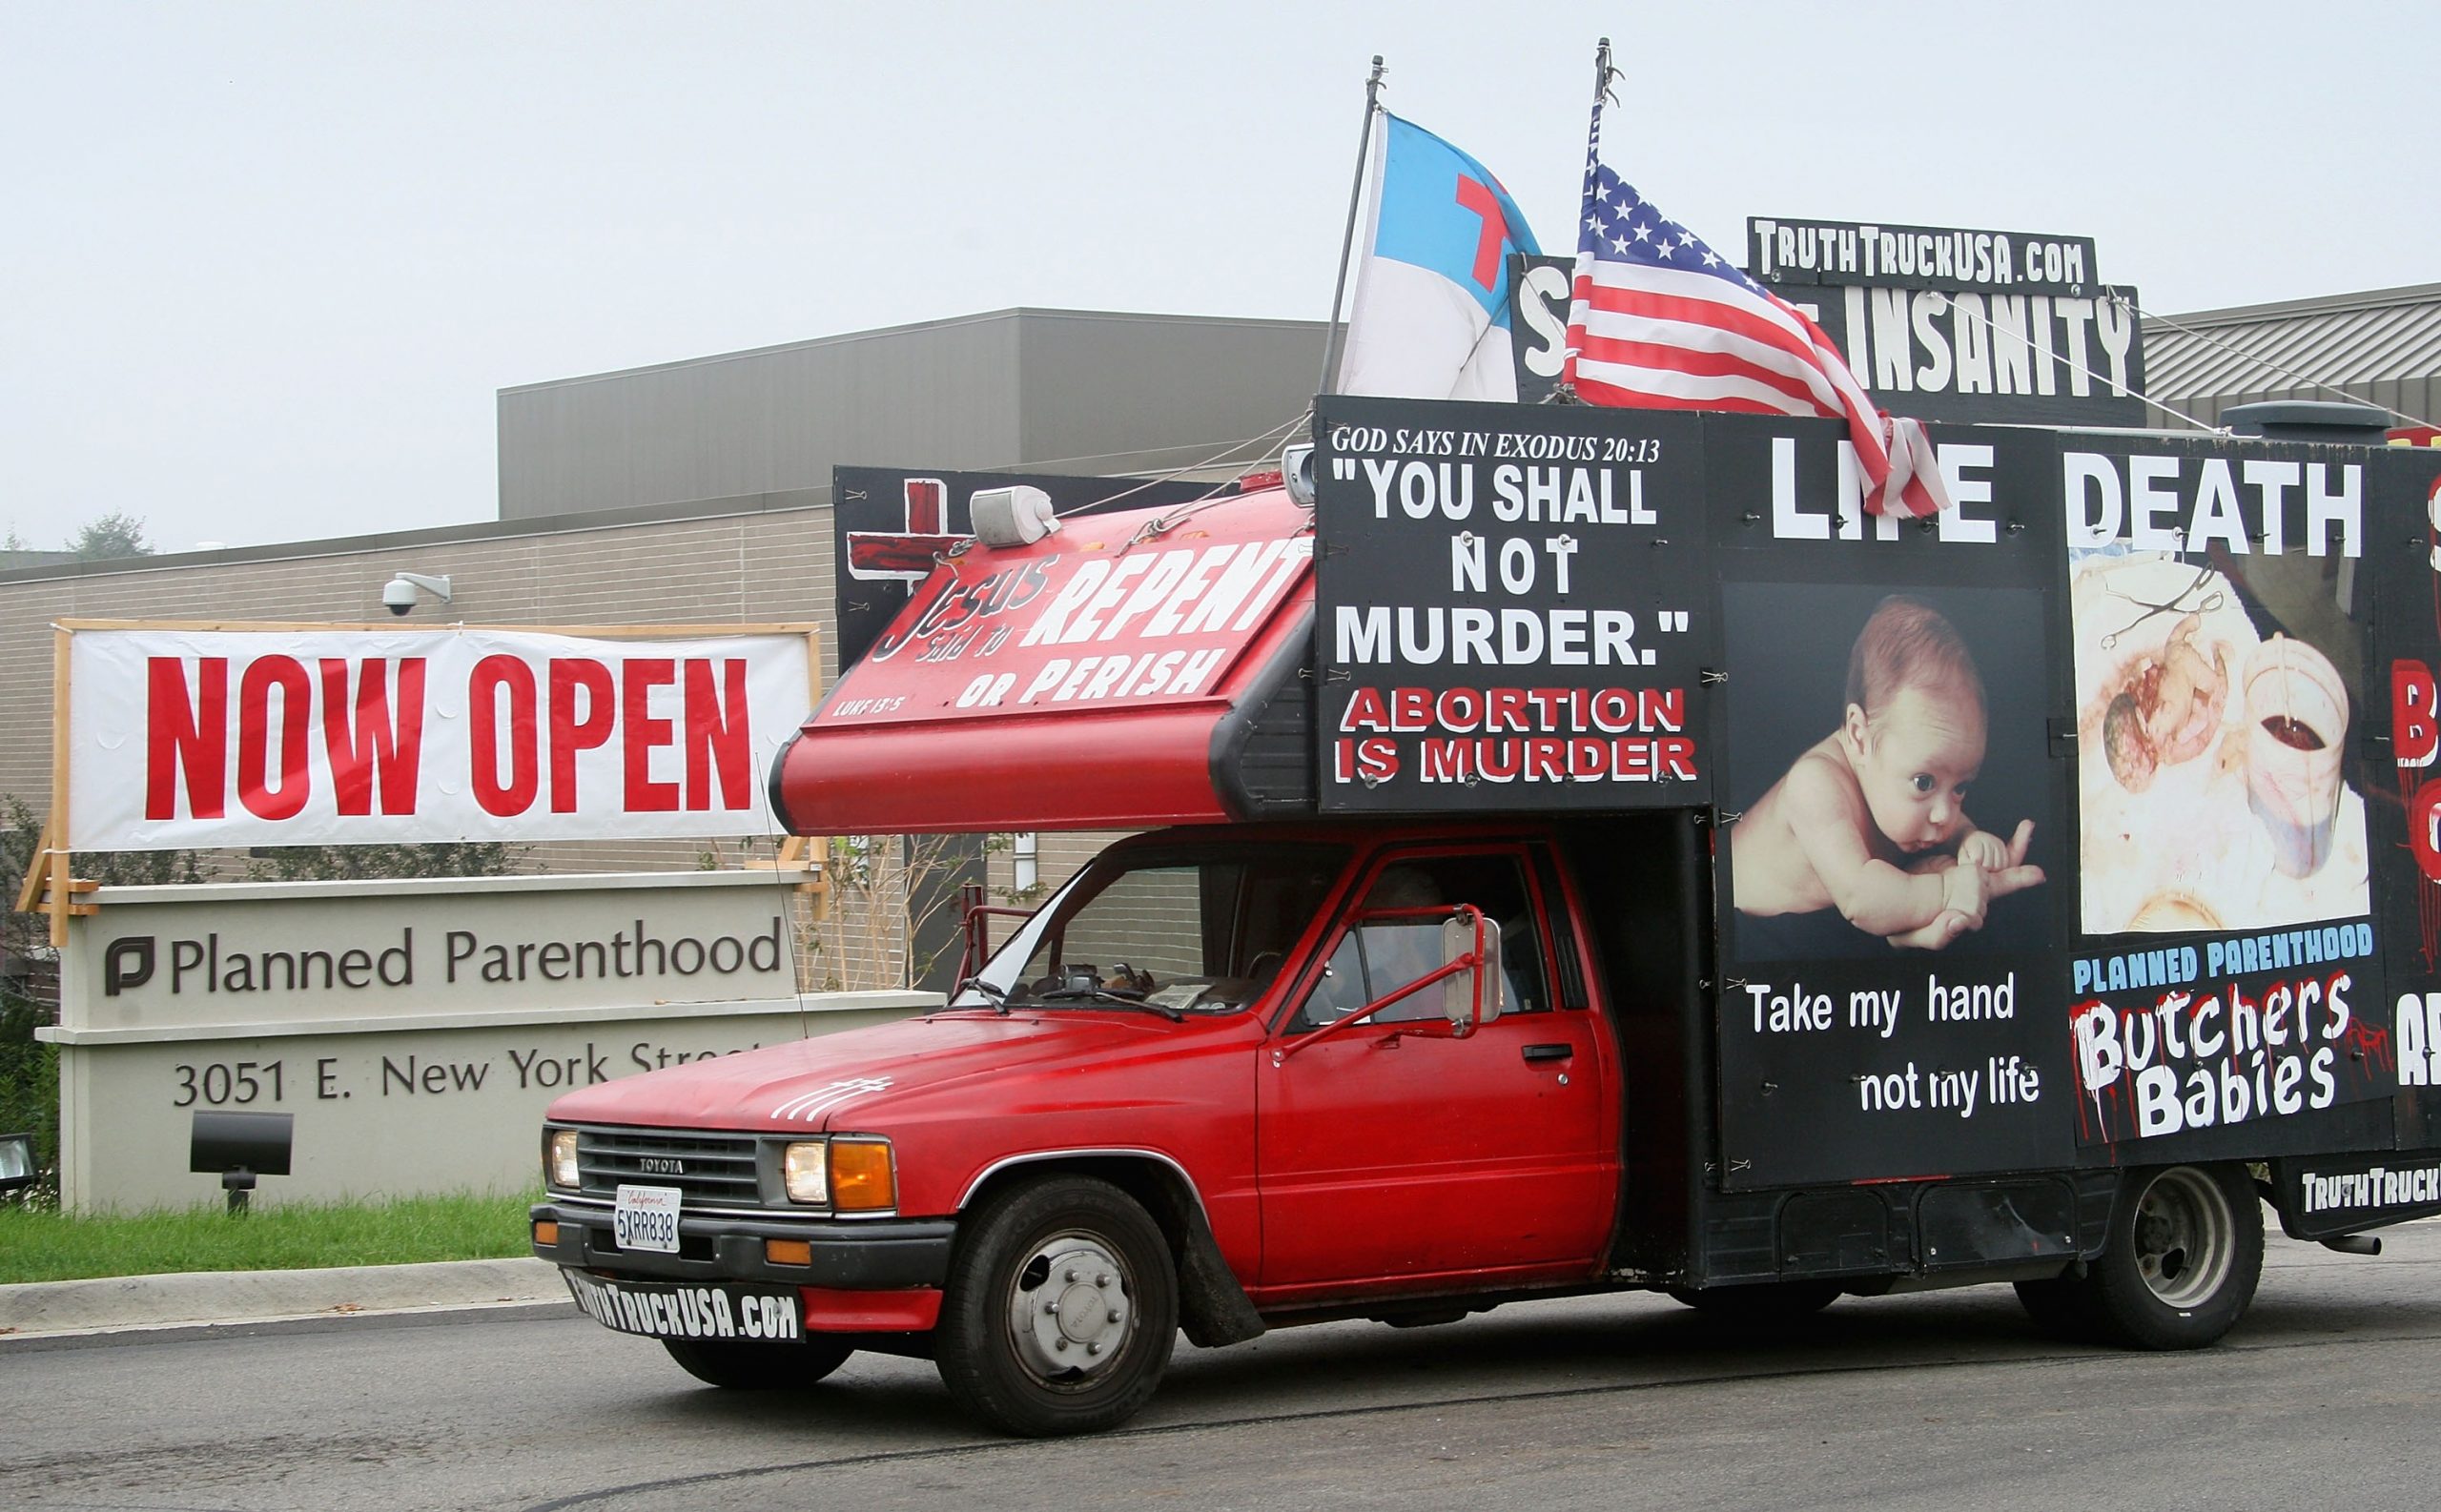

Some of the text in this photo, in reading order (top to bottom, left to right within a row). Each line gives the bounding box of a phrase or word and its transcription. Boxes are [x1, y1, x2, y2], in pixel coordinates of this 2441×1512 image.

[1844, 286, 2132, 398] INSANITY
[1332, 426, 1660, 462] GOD SAYS IN EXODUS 20:13
[1332, 459, 1657, 524] "YOU SHALL
[1772, 438, 1997, 543] LIE
[2063, 452, 2362, 558] DEATH
[1019, 536, 1314, 648] REPENT
[1451, 536, 1578, 595] NOT
[1336, 606, 1689, 665] MURDER."
[832, 699, 872, 716] LUKE
[955, 648, 1226, 708] OR PERISH
[1339, 687, 1685, 733] ABORTION
[145, 654, 751, 821] NOW OPEN
[1335, 738, 1698, 784] IS MURDER
[172, 916, 782, 993] Planned Parenthood
[2073, 923, 2373, 994] PLANNED PARENTHOOD
[1746, 971, 2014, 1038] Take my hand
[2069, 969, 2352, 1092] Butchers
[174, 1061, 285, 1107] 3051
[318, 1058, 352, 1100] E.
[382, 1054, 489, 1098] New
[507, 1043, 609, 1088] York
[1860, 1055, 2040, 1118] not my life
[2135, 1046, 2336, 1138] Babies
[640, 1158, 684, 1174] TOYOTA
[617, 1210, 674, 1242] 5XRR838
